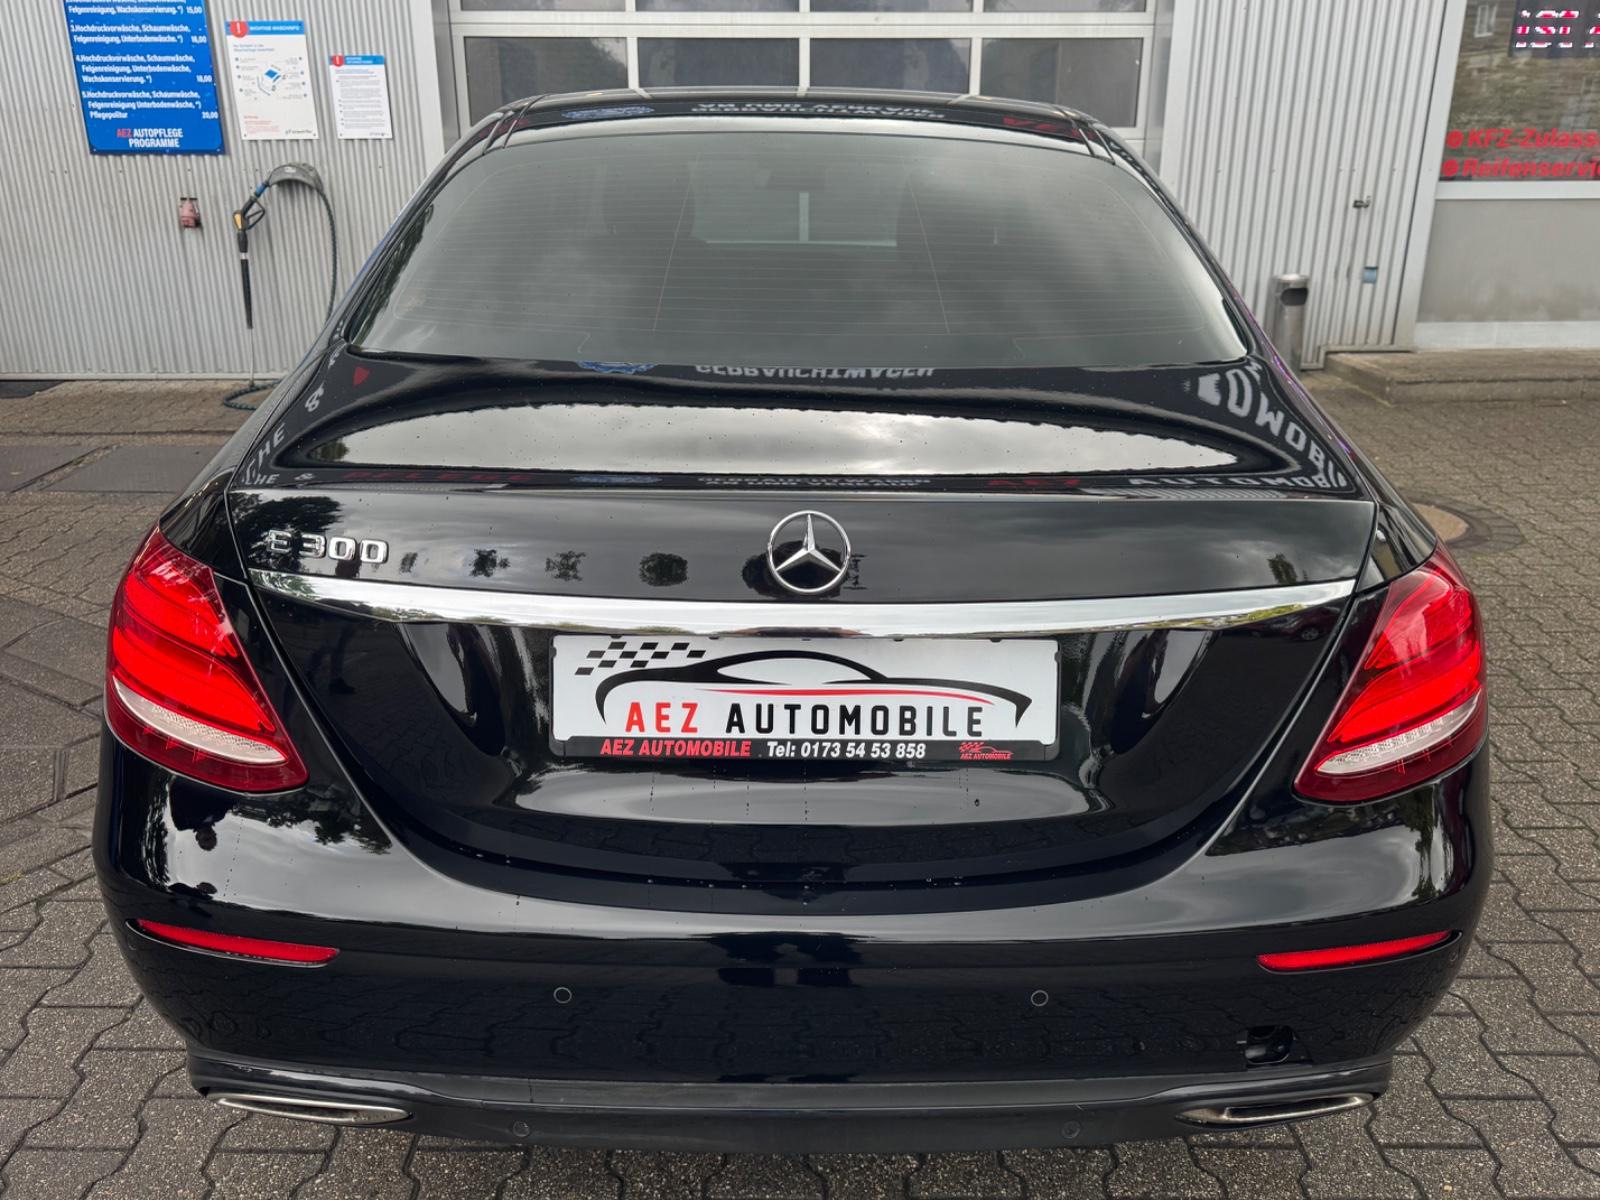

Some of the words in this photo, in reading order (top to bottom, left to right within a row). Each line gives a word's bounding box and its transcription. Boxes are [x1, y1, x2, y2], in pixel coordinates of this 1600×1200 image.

[117, 128, 132, 138] AEZ
[133, 128, 183, 138] AUTOPFLEGE
[129, 138, 180, 148] PROGRAMME
[1462, 156, 1600, 177] Reifenservi
[625, 702, 698, 733] AEZ
[726, 703, 983, 737] AUTOMOBILE
[601, 739, 634, 756] AEZ
[639, 740, 751, 757] AUTOMOBILE
[767, 741, 796, 757] Tel:
[800, 741, 840, 758] 0173
[845, 742, 866, 759] 54
[871, 742, 891, 759] 53
[896, 743, 926, 759] 858
